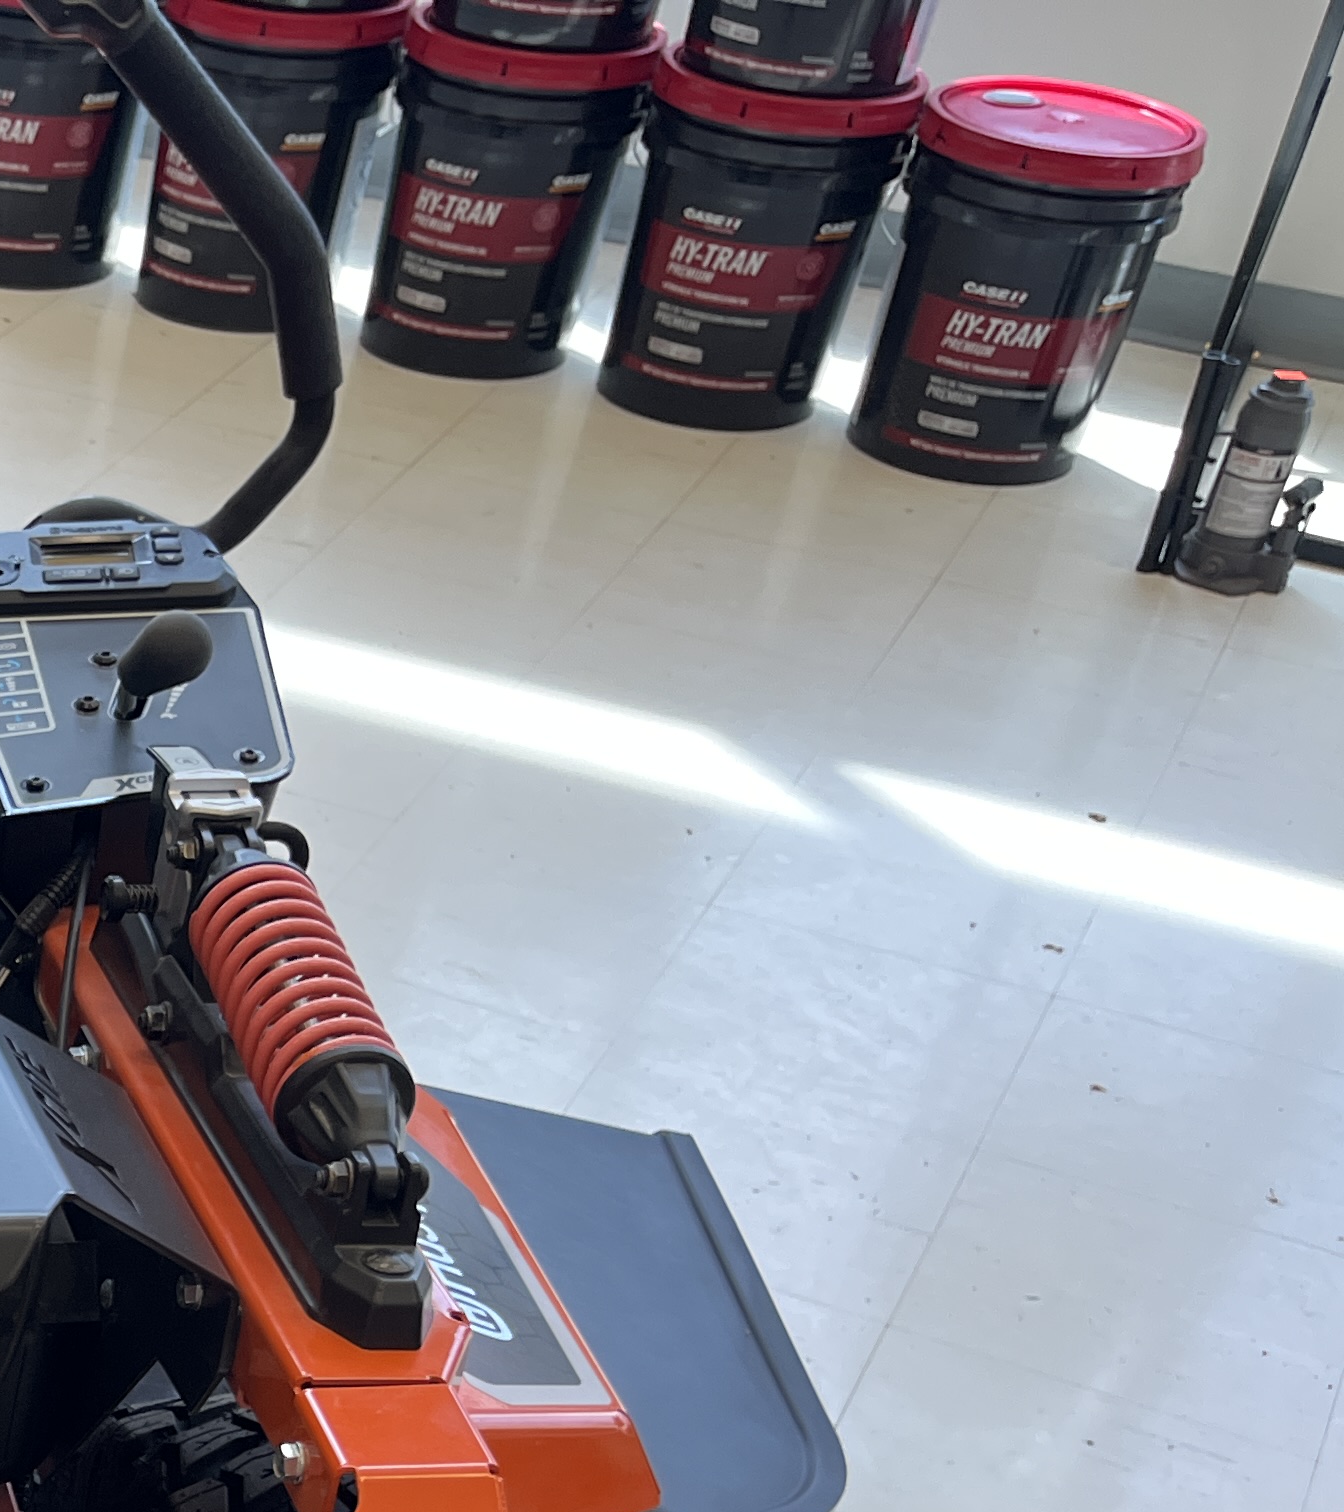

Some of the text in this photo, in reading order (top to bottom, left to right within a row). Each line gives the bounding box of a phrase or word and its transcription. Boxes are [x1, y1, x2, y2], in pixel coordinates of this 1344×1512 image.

[415, 186, 503, 228] HY-TRAN
[670, 235, 768, 277] HY-TRAN
[945, 309, 1050, 350] HY-TRAN
